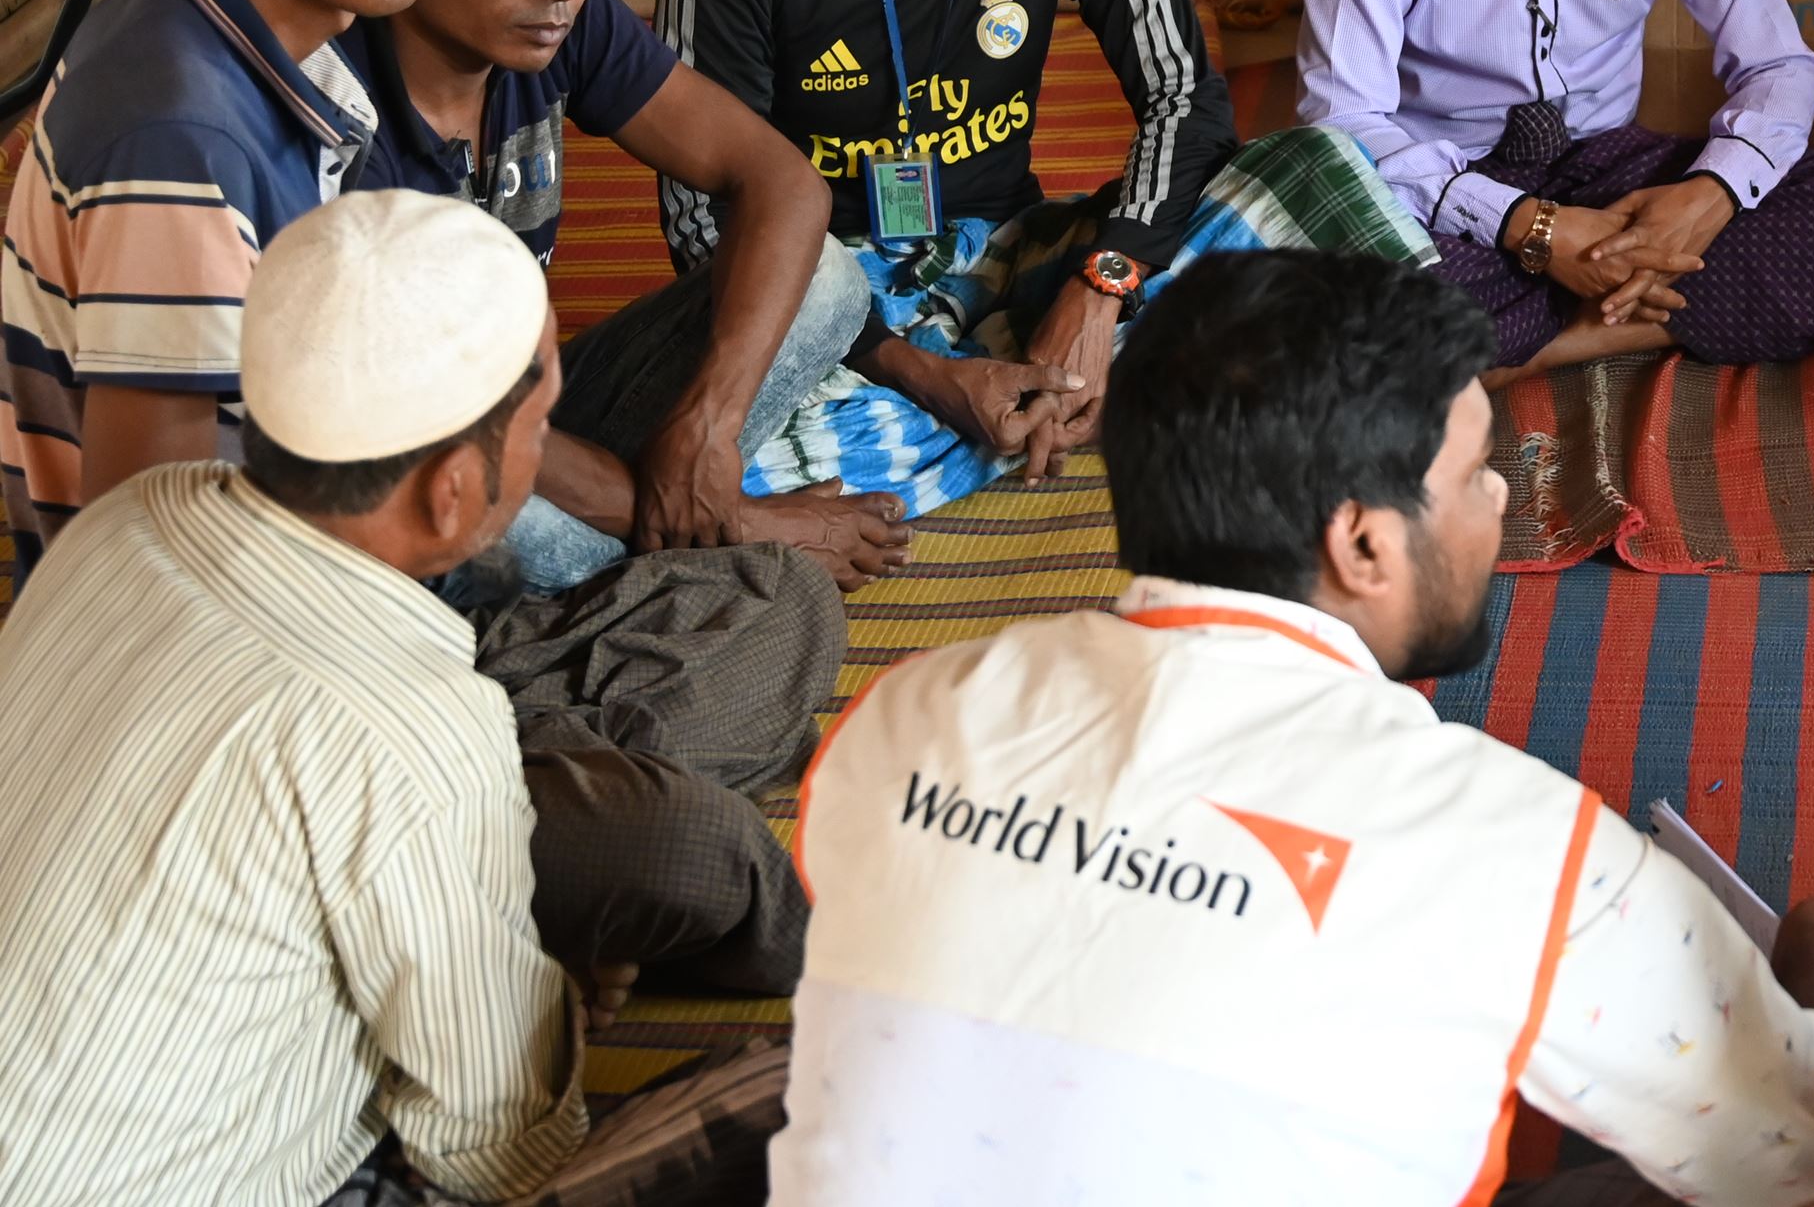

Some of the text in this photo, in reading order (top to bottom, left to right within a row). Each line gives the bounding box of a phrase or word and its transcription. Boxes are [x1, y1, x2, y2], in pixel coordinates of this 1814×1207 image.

[801, 73, 869, 92] adidas
[898, 73, 970, 121] Fly
[900, 771, 1253, 917] World Vision
